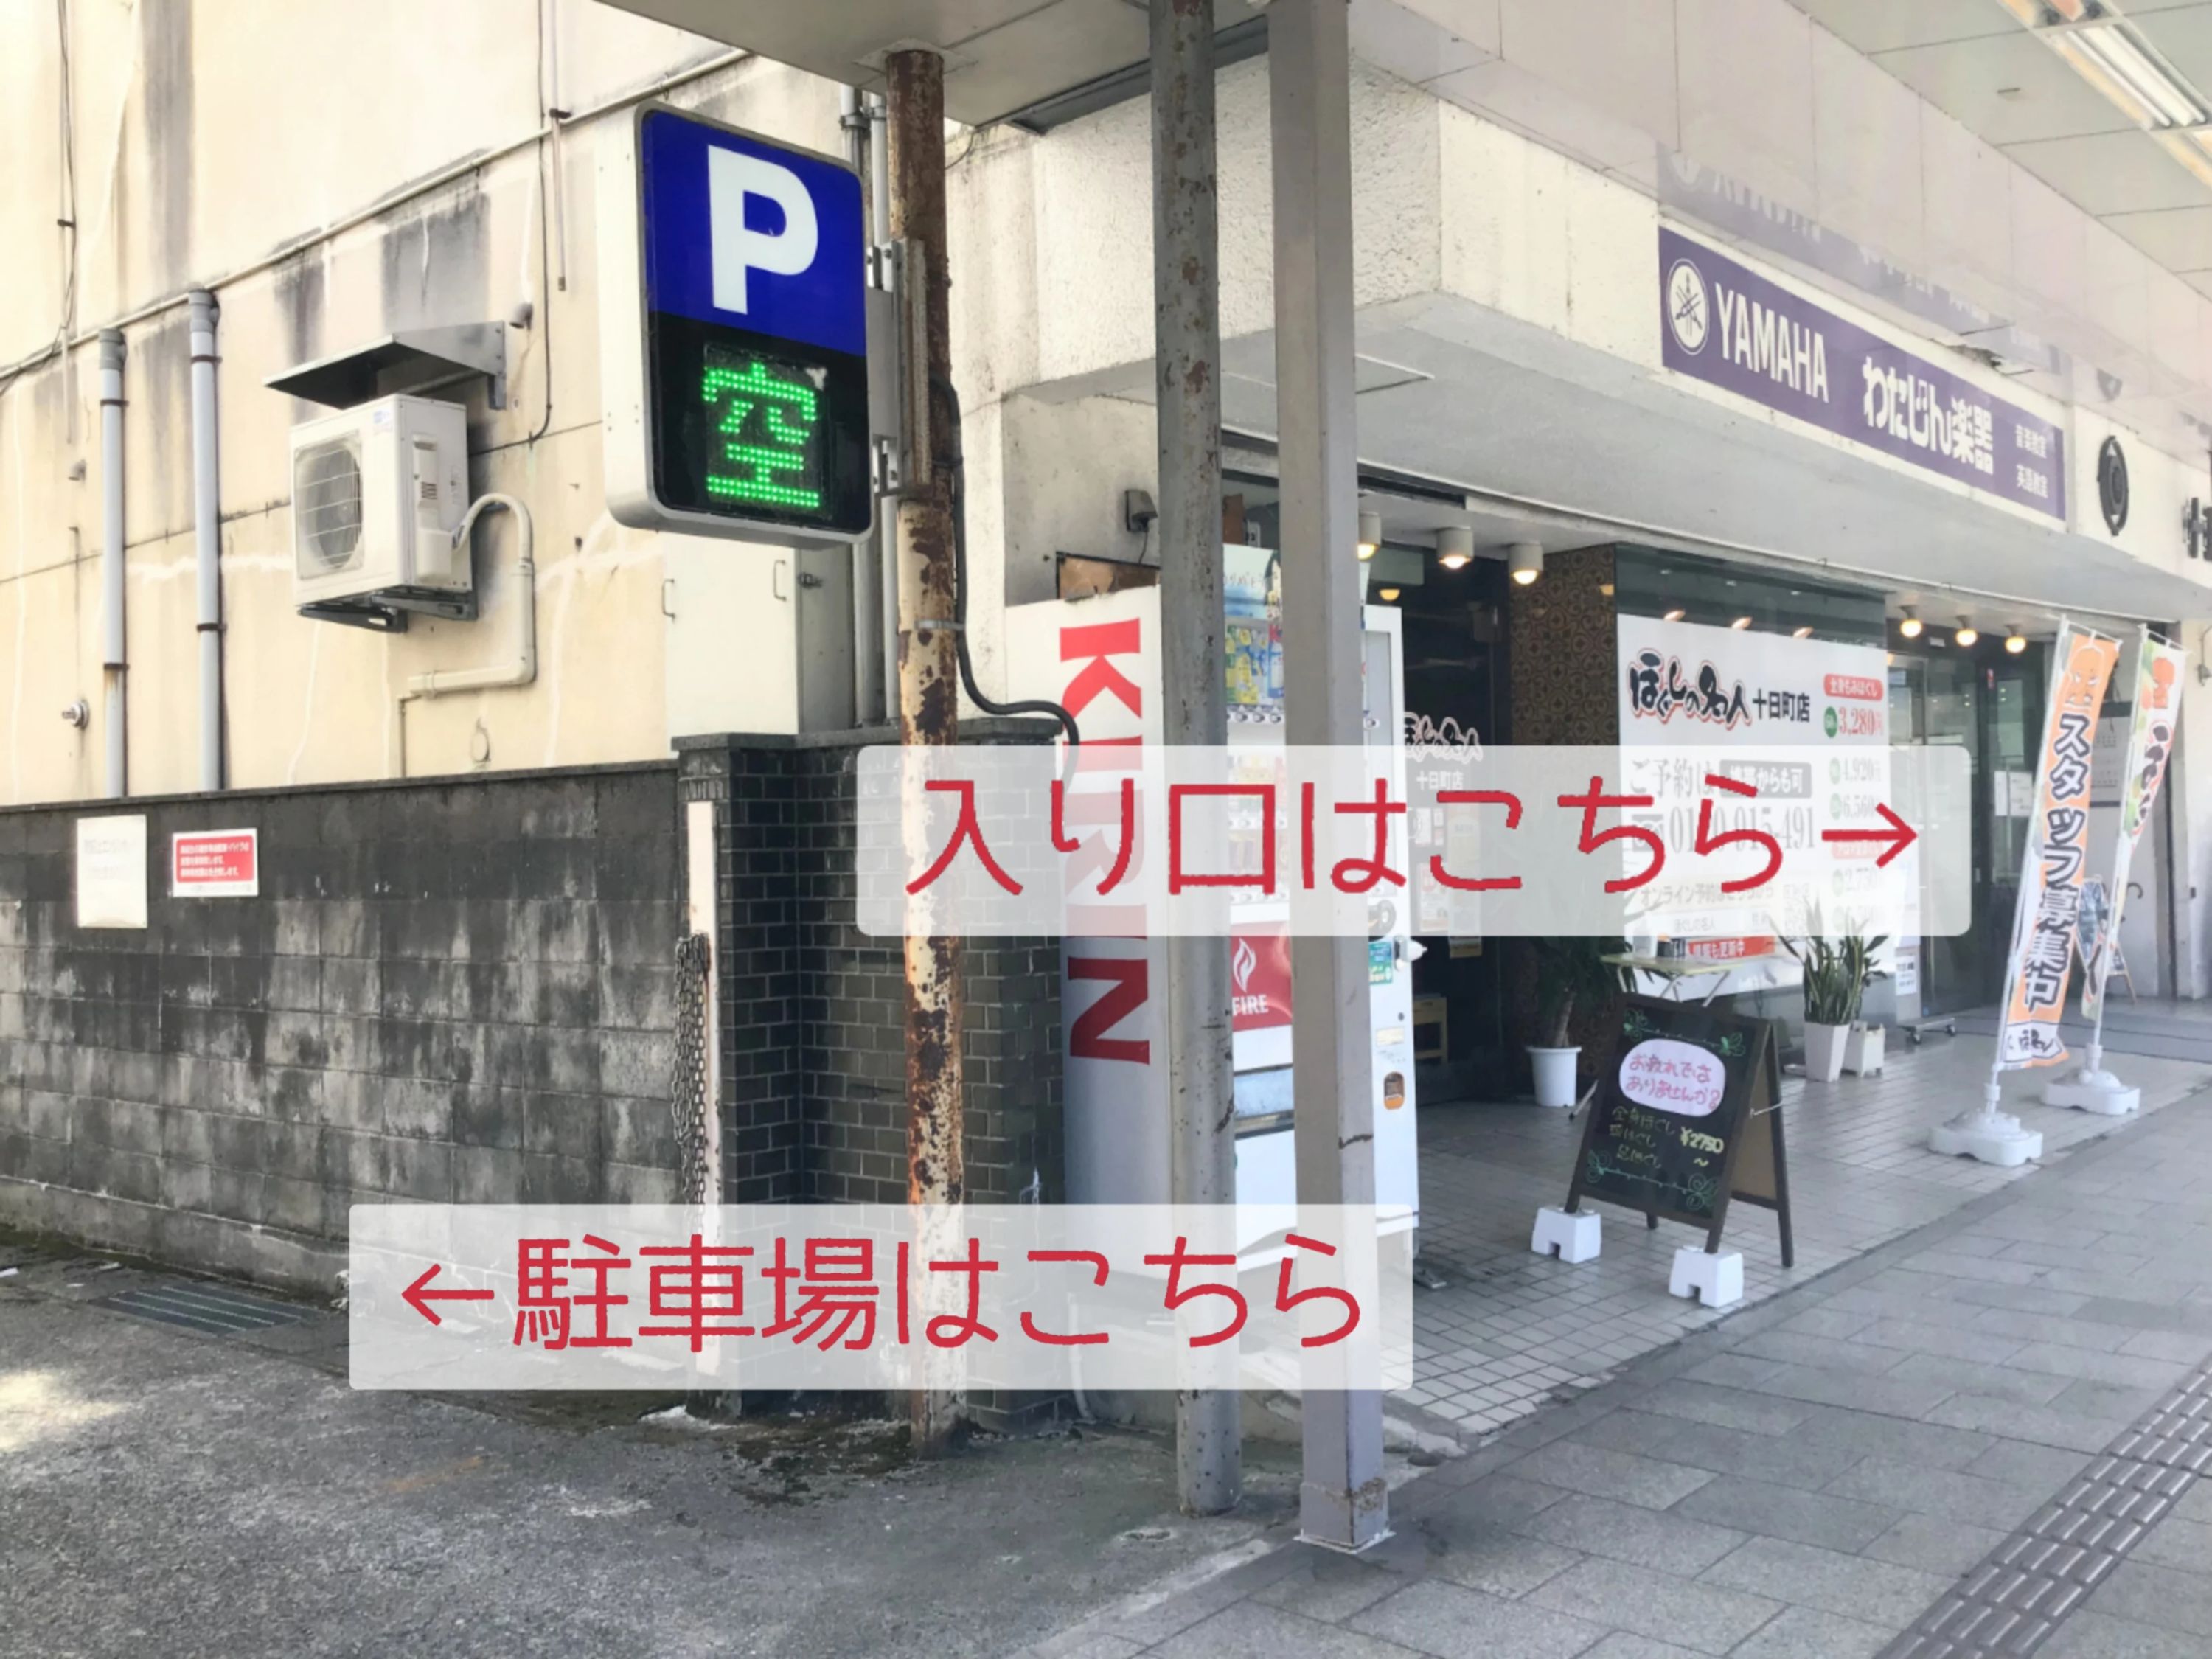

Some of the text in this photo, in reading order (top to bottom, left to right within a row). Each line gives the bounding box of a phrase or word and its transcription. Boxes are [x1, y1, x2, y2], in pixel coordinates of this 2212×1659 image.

[708, 144, 818, 315] P
[1715, 282, 1829, 403] YAMAHA
[702, 361, 819, 507] 空
[1861, 355, 1994, 476] わたじん楽器
[1628, 648, 1750, 729] ほぐしの名人
[1753, 688, 1811, 724] 十日町店
[1059, 616, 1150, 1065] KIRIN
[1416, 770, 1464, 791] 十日町店
[1232, 995, 1268, 1016] FIRE
[1628, 1053, 1711, 1083] お疲れでは
